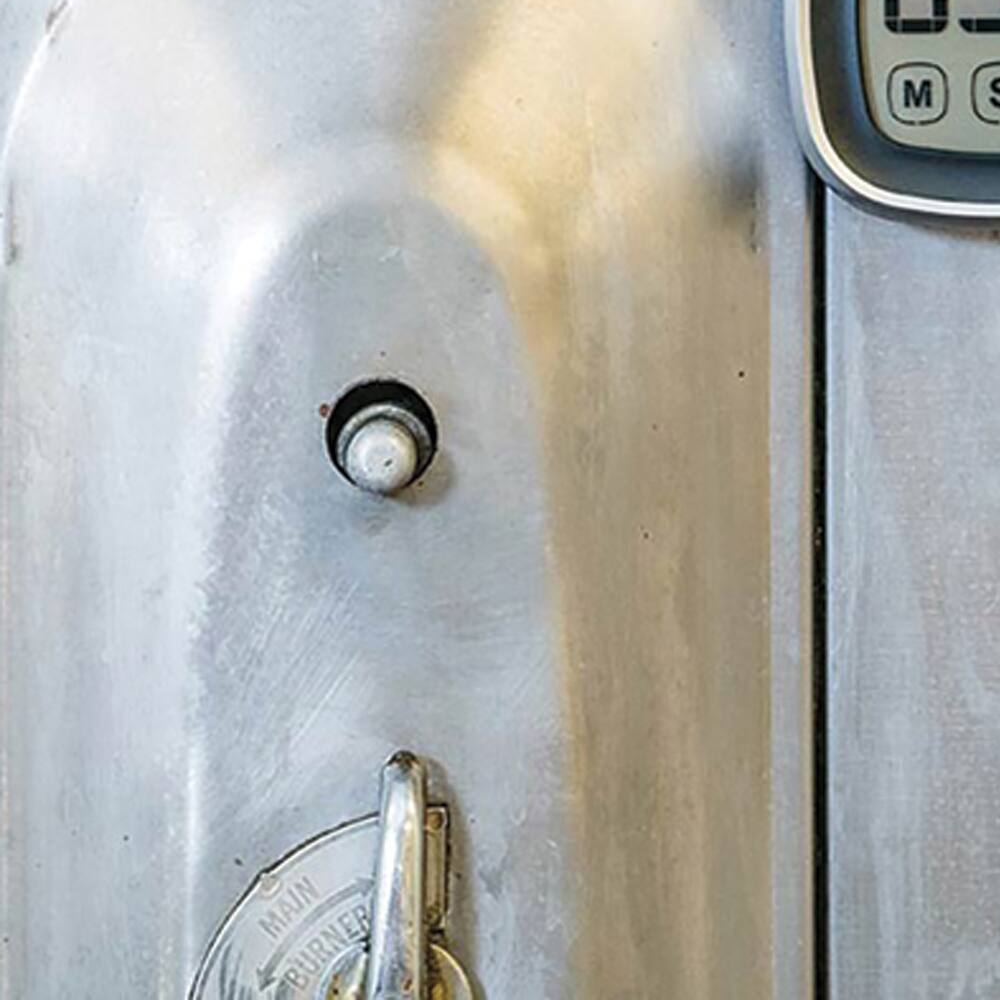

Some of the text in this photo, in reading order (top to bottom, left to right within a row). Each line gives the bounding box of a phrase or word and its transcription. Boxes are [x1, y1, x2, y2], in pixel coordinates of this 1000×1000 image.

[902, 80, 932, 108] M
[257, 875, 320, 939] MAIN
[284, 905, 369, 991] BURNER
